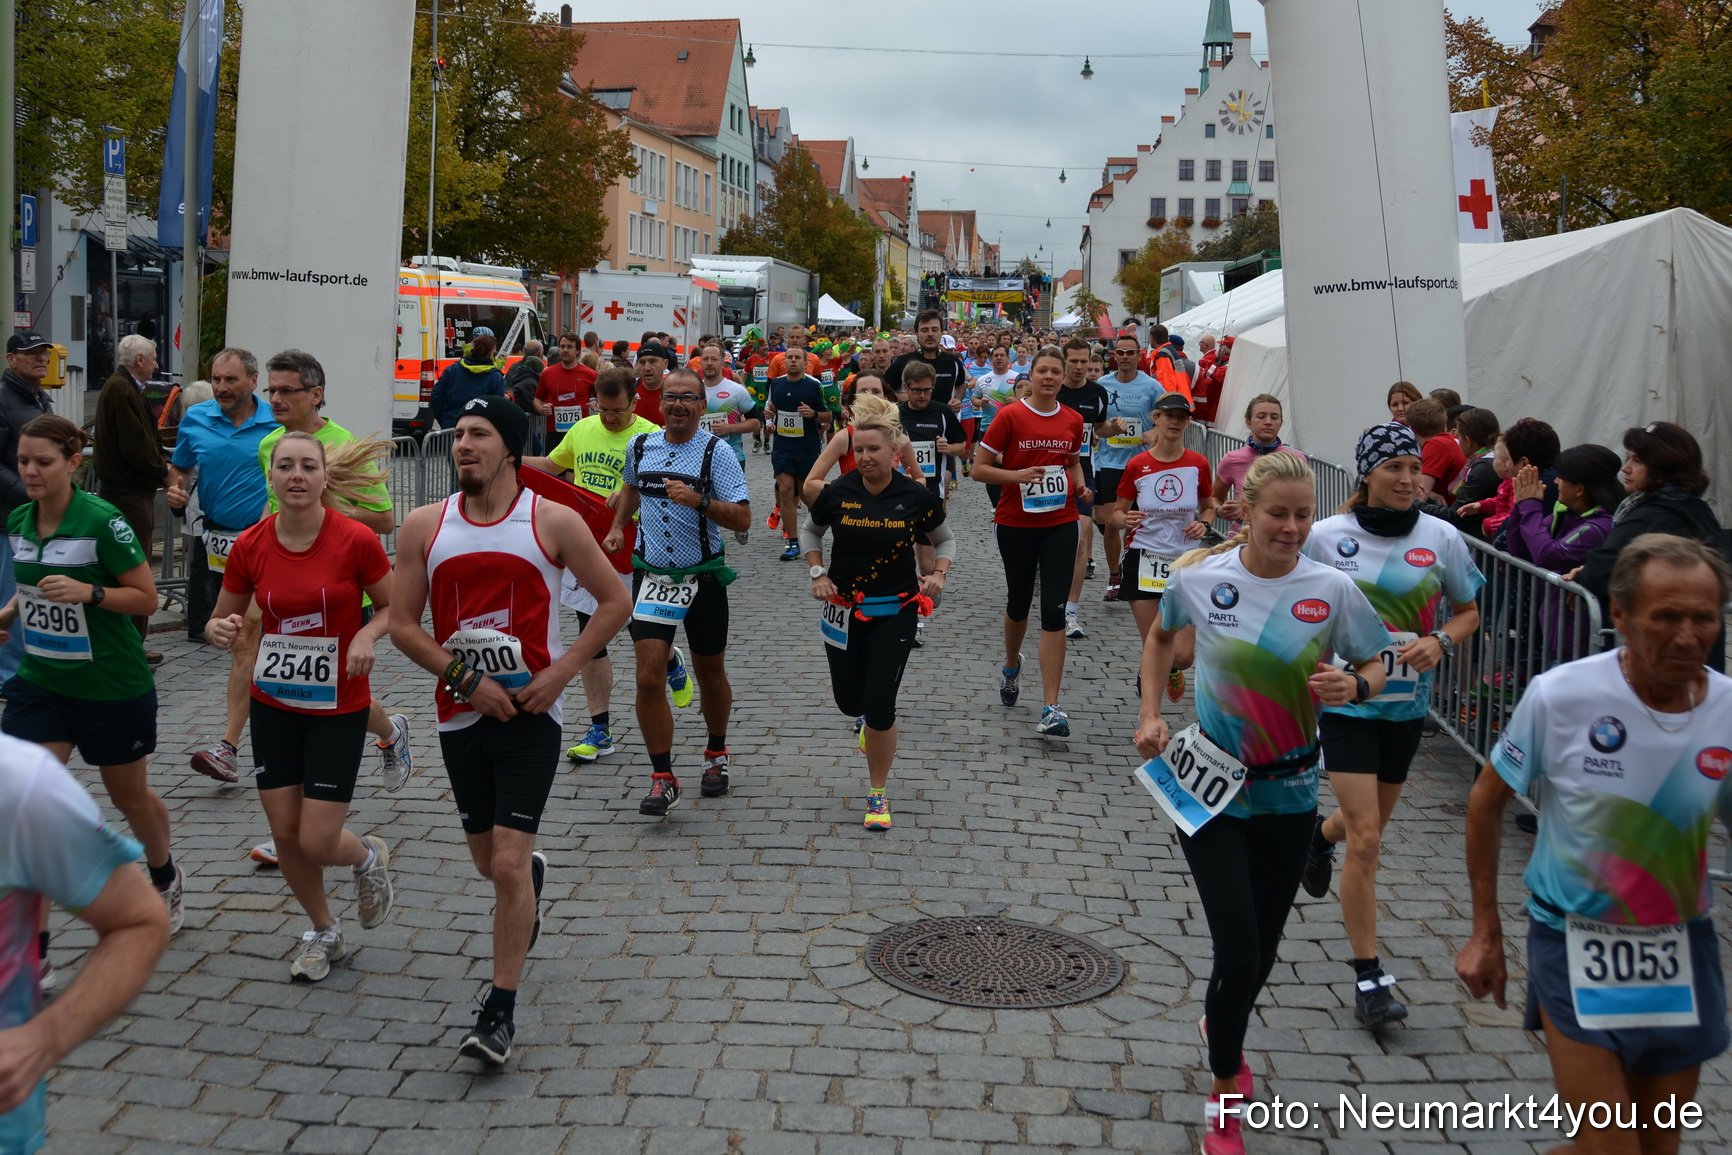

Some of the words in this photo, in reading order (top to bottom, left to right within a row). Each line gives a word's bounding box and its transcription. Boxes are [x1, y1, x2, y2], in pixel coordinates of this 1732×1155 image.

[109, 140, 120, 169] P
[25, 202, 33, 240] P
[231, 268, 368, 286] www.bmw-laufsport.de
[1313, 276, 1458, 295] www.bmw-laufsport.de
[627, 301, 663, 309] Bayerisches
[557, 412, 580, 422] 3075
[784, 418, 795, 427] 88
[1019, 439, 1069, 449] NEUMARKT
[1026, 475, 1064, 496] 2160
[841, 514, 906, 528] Marathon-Team
[1335, 560, 1359, 568] PARTL
[1408, 552, 1434, 564] Hervis
[644, 582, 692, 606] 2823
[25, 600, 80, 634] 2596
[653, 606, 676, 618] Peter
[1208, 612, 1239, 623] PARTL
[1297, 603, 1328, 618] Hervis
[292, 619, 313, 629] DEHN
[472, 617, 495, 630] DEHN
[1208, 619, 1239, 629] Neumarkt
[263, 640, 287, 650] PARTL
[288, 642, 325, 653] Neumarkt
[466, 635, 504, 646] Neumarkt
[452, 645, 518, 674] 2200
[262, 652, 331, 683] 2546
[277, 687, 313, 700] Annika
[1191, 740, 1231, 774] Neumarkt
[1583, 755, 1625, 772] PARTL
[1170, 736, 1229, 808] 3010
[1583, 767, 1625, 780] Neumarkt
[1157, 769, 1183, 808] Julia
[1570, 921, 1613, 936] PARTL
[1583, 938, 1679, 982] 3053
